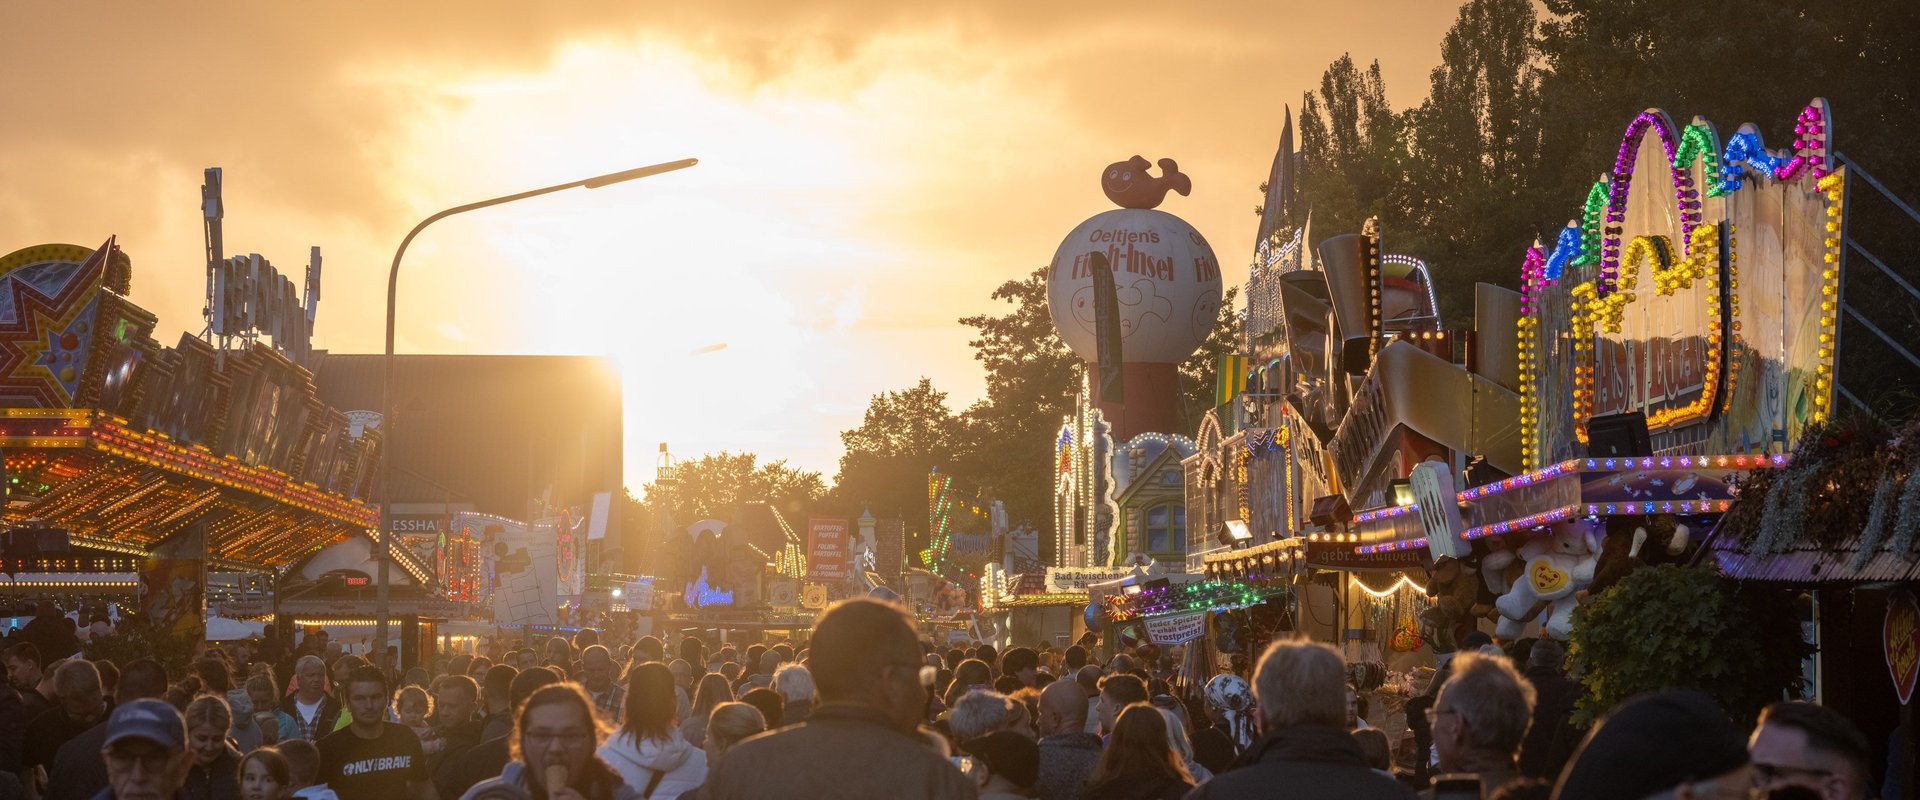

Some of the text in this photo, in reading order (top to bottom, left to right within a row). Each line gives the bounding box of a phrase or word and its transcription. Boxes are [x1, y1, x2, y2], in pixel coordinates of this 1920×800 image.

[1071, 243, 1175, 281] Fish-Insel
[813, 550, 842, 558] KARTOFFEL
[1054, 572, 1072, 580] Bad
[1149, 614, 1202, 628] Jeder Spieler
[1153, 626, 1201, 641] Trostpreis!
[1157, 623, 1195, 634] erhält einen
[378, 755, 412, 771] BRAVE
